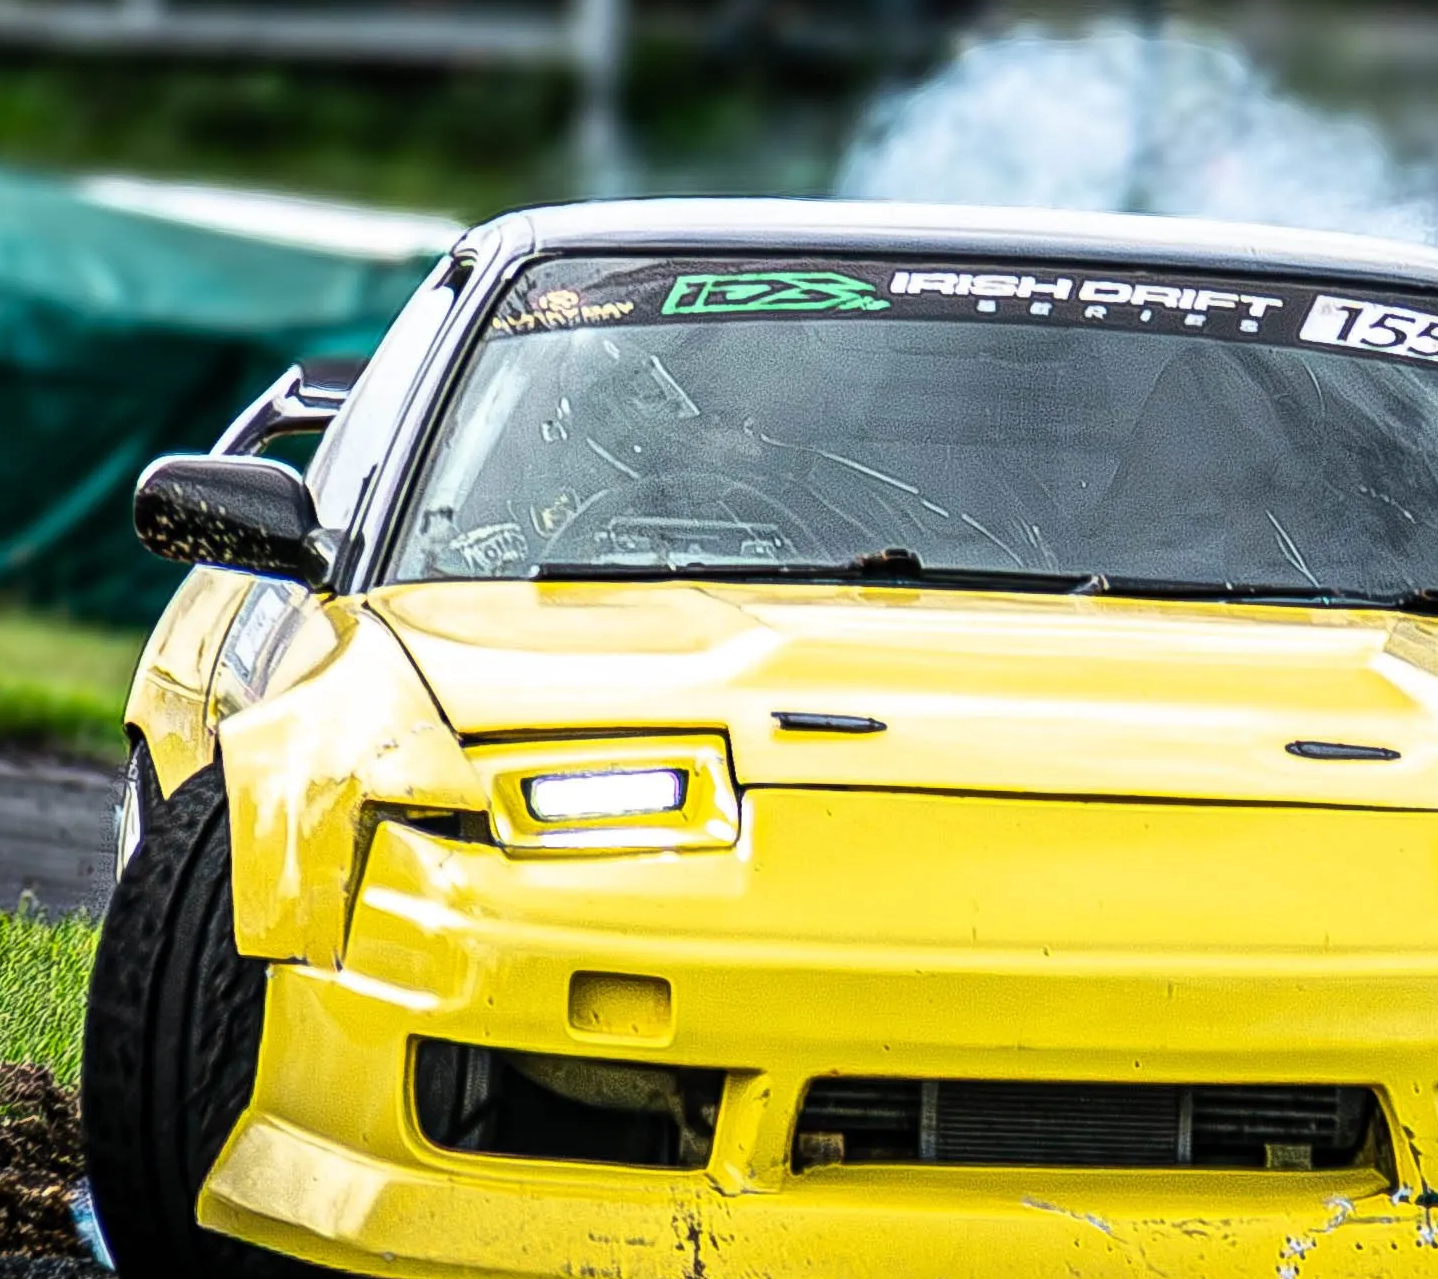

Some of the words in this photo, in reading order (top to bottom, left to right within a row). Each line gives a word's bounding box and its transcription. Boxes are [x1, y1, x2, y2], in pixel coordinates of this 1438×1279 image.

[889, 271, 1073, 300] IRISH
[1078, 280, 1284, 317] DRIFT
[976, 300, 1259, 333] SERIES
